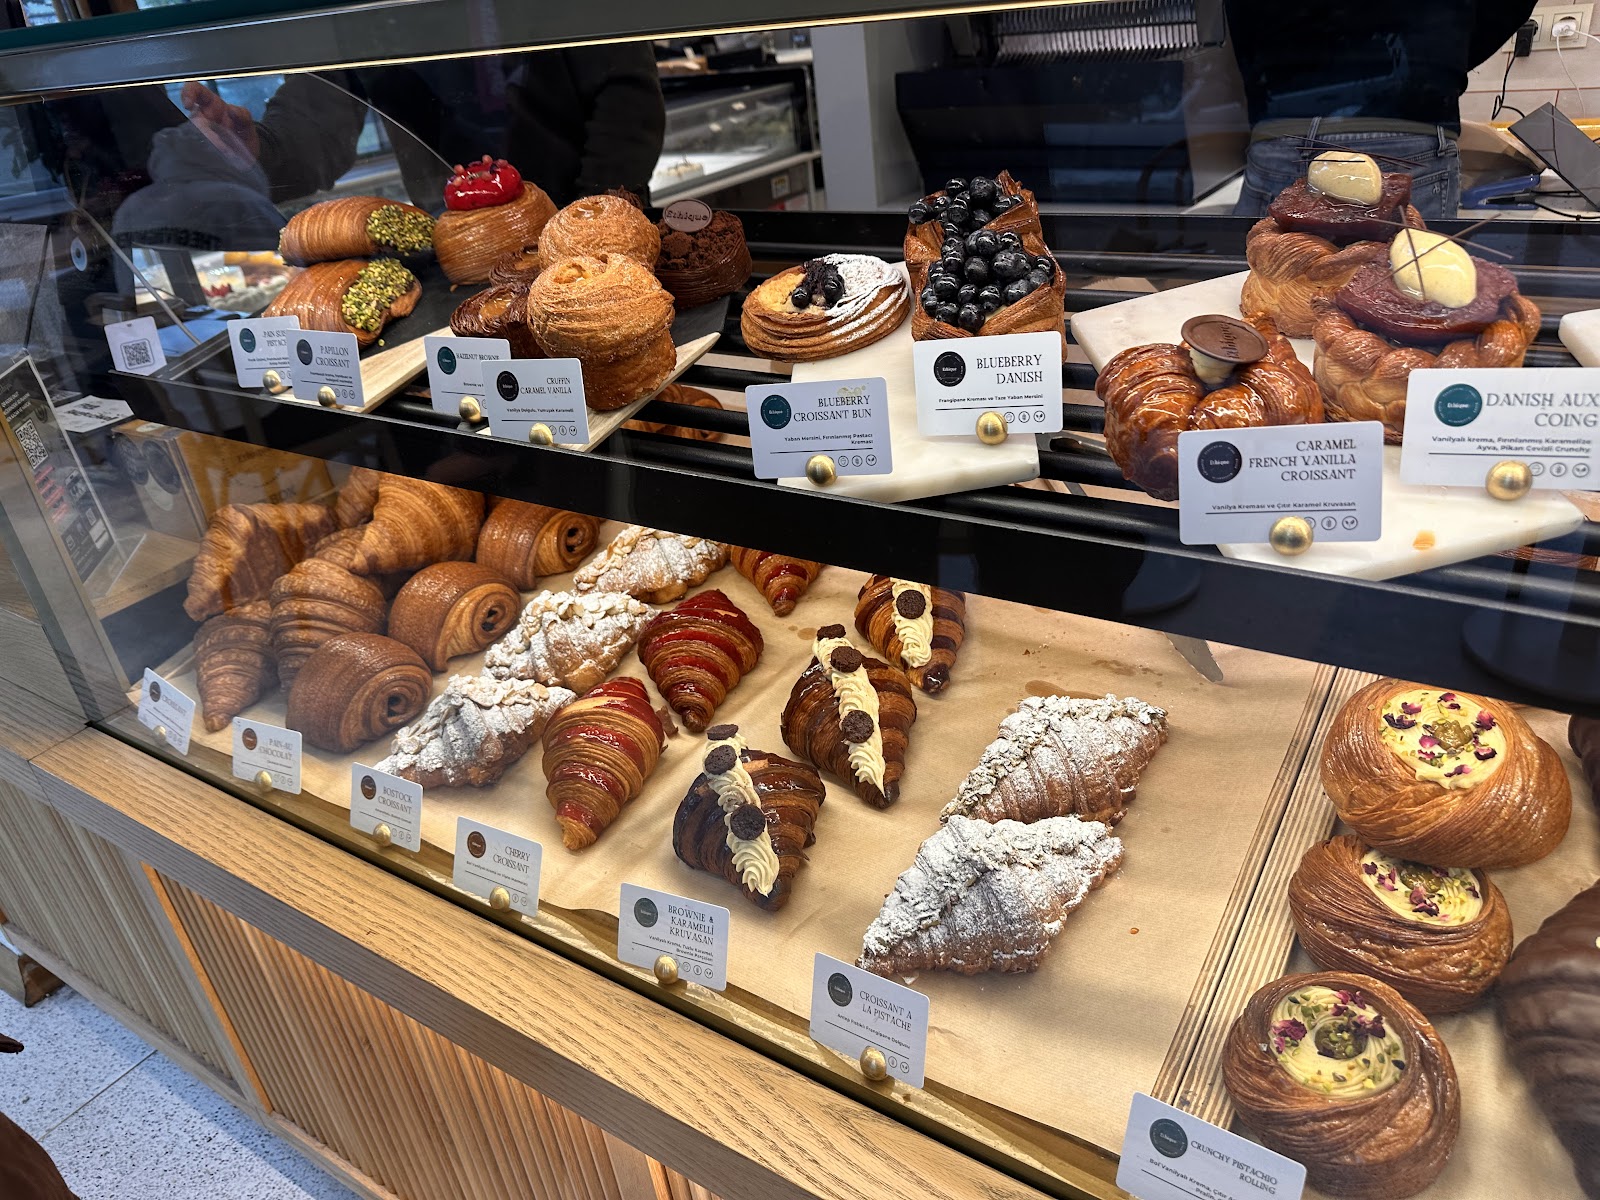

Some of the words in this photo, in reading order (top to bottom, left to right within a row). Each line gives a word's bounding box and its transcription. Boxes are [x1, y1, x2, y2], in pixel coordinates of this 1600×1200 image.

[666, 210, 709, 222] Ethique
[320, 345, 349, 356] PAPILLON
[315, 356, 351, 368] CROISSANT
[976, 354, 1042, 369] BLUEBERRY
[546, 377, 571, 385] CRUFFIN
[996, 371, 1043, 385] DANISH
[546, 386, 572, 394] VANILLA
[818, 394, 871, 408] BLUEBERRY
[1486, 393, 1554, 407] DANISH
[1560, 393, 1600, 407] AUX
[793, 411, 848, 422] CROISSANT
[852, 408, 872, 419] BUN
[1534, 412, 1598, 428] COING
[1296, 439, 1357, 452] CARAMEL
[1249, 456, 1298, 468] FRENCH
[1300, 454, 1356, 466] VANILLA
[1280, 469, 1357, 482] CROISSANT
[383, 786, 412, 803] BOSTOCK
[378, 795, 412, 814] CROISSANT
[504, 846, 531, 861] CHERRY
[493, 855, 530, 874] CROISSANT
[668, 904, 706, 922] BROWNIE
[671, 916, 714, 935] KARAMELLİ
[669, 927, 713, 945] KRUVASAN
[860, 990, 904, 1016] CROISSANT
[906, 1010, 912, 1020] A
[862, 1004, 872, 1015] LA
[873, 1008, 911, 1032] PISTACHE
[1190, 1140, 1230, 1164] CRUNCHY
[1231, 1158, 1278, 1185] PISTACHIO
[1189, 1177, 1212, 1192] Krema,
[1239, 1172, 1276, 1195] ROLLING
